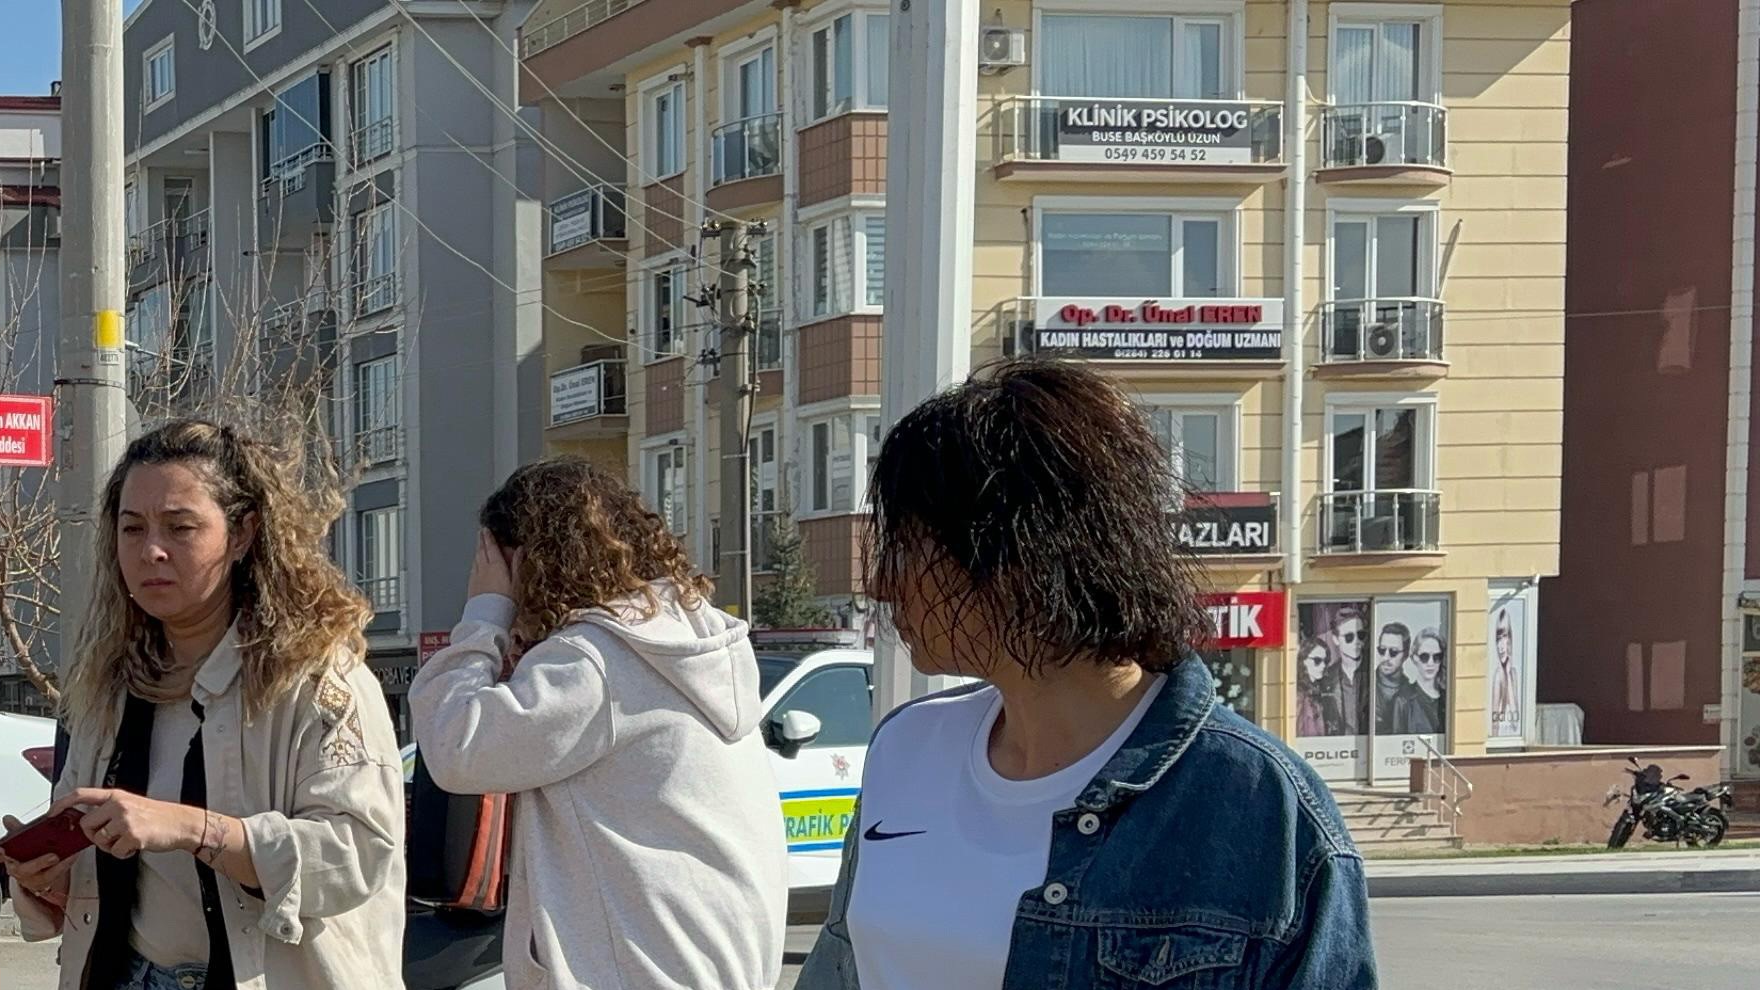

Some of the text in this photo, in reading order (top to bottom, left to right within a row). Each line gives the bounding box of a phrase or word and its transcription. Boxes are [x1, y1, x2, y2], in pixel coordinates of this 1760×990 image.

[1068, 103, 1248, 129] KLİNİK PSİKOLOG
[1092, 131, 1123, 142] BUSE
[1104, 147, 1206, 161] 0549 459 54 52
[1061, 300, 1263, 326] Op. Dr. Ünal EREN
[1040, 330, 1281, 349] KADIN HASTALIKLARI ve DOĞUM UZMANI
[5, 413, 40, 430] AKKAN
[1172, 521, 1269, 547] AZLARI
[1206, 596, 1264, 639] TİK
[1304, 749, 1360, 760] POLICE
[784, 808, 835, 838] RAFİK
